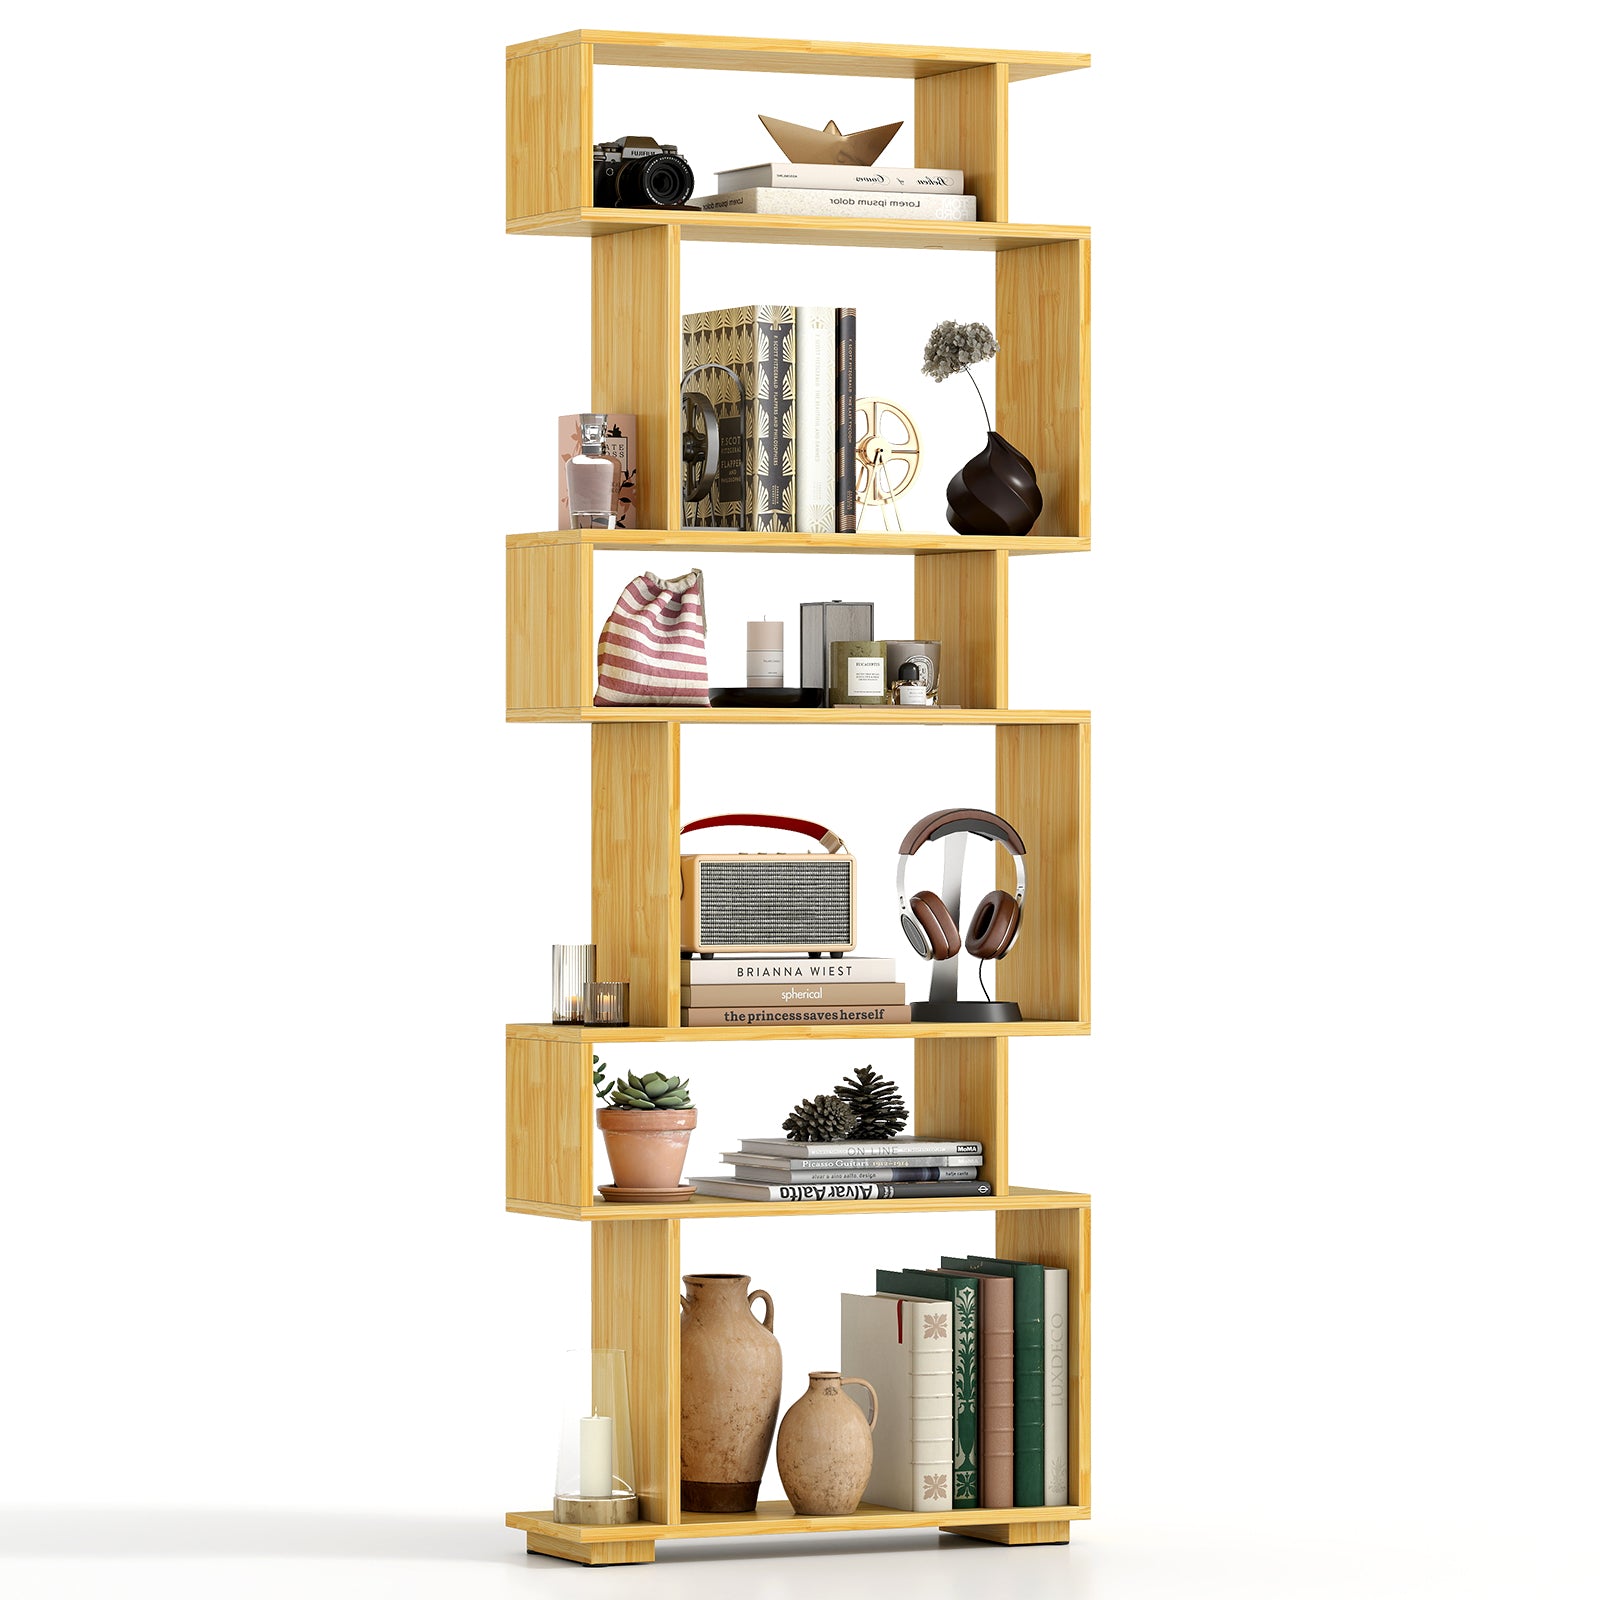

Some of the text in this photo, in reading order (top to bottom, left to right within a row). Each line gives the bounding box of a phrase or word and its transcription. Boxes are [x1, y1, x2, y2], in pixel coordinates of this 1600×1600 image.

[737, 966, 852, 977] BRIANNA WIEST
[781, 987, 823, 1002] spherical
[724, 1008, 885, 1024] the princess saves herself
[847, 1147, 865, 1156] ON
[871, 1146, 898, 1156] LINE
[802, 1160, 834, 1168] Picasso
[835, 1158, 869, 1167] Guitars
[780, 1185, 826, 1201] Aalto
[827, 1185, 874, 1201] Alvar
[1052, 1313, 1064, 1407] LUXDECO
